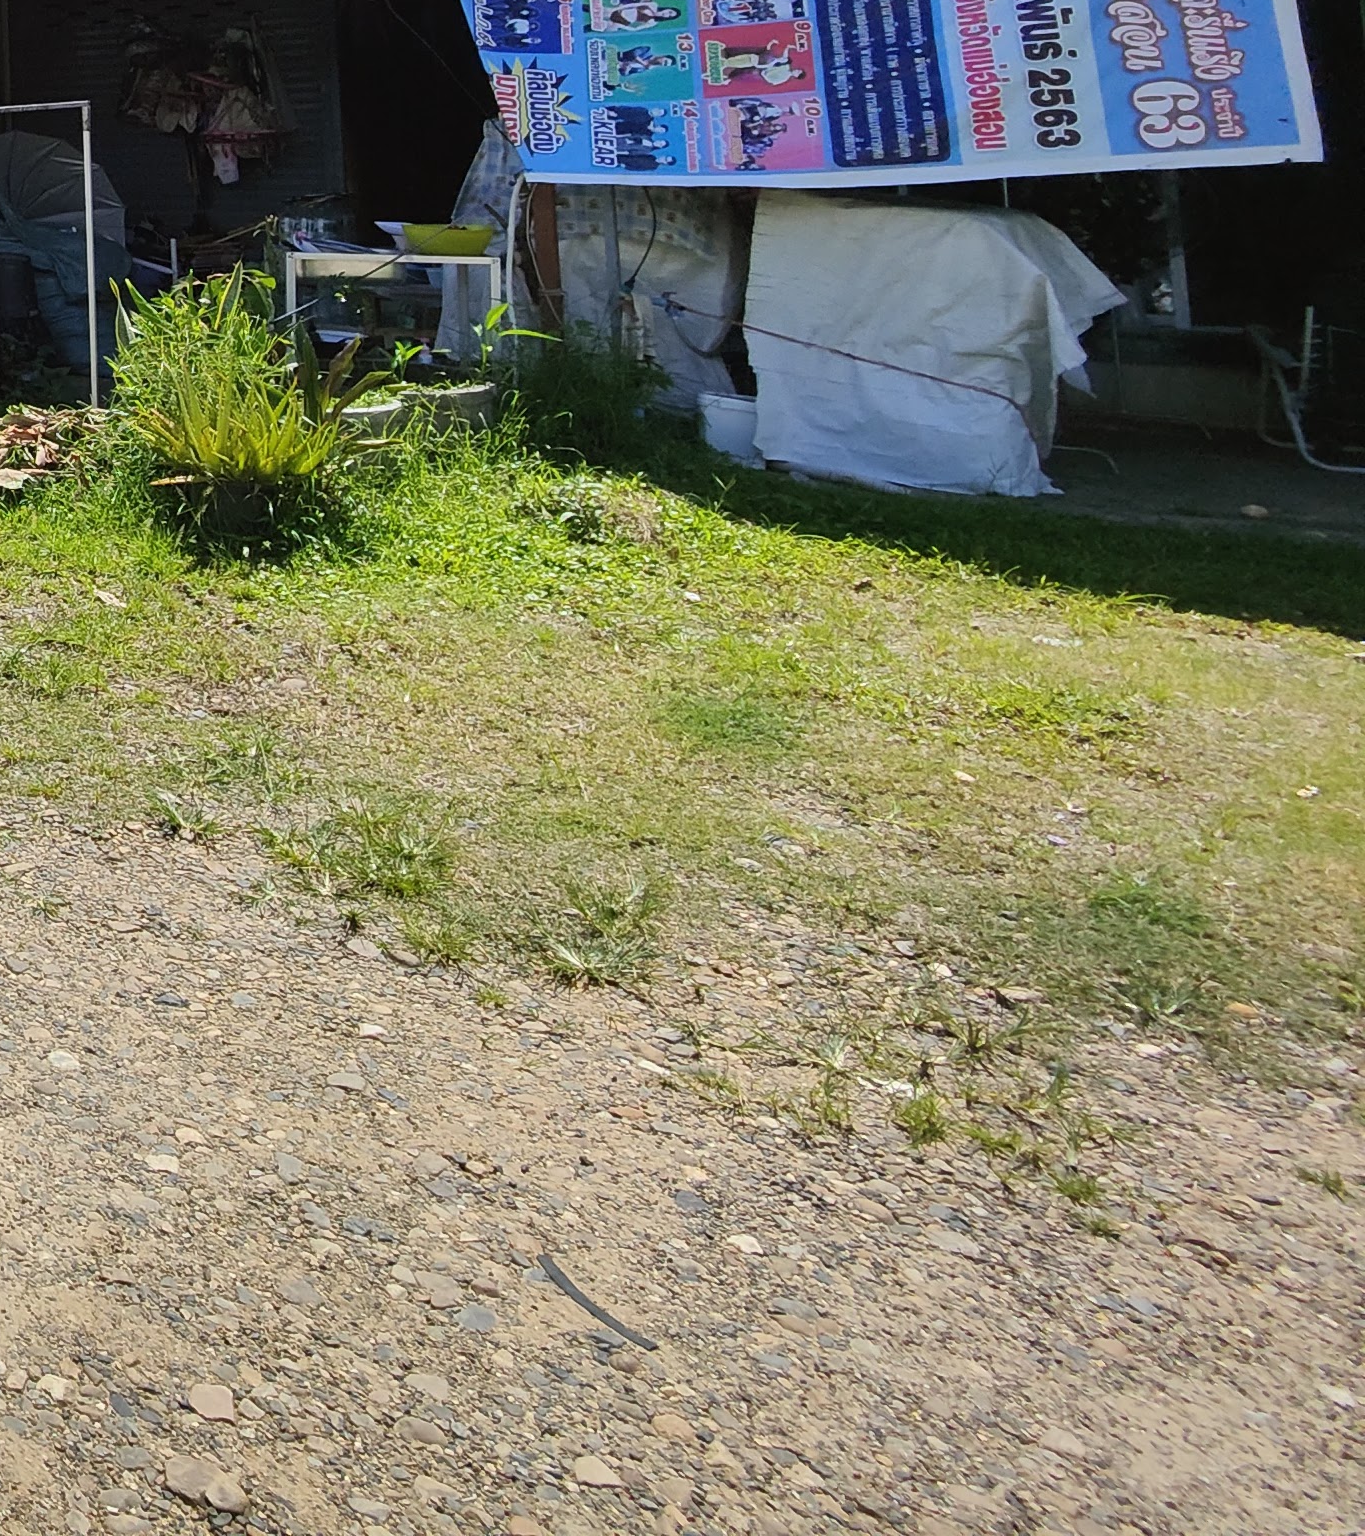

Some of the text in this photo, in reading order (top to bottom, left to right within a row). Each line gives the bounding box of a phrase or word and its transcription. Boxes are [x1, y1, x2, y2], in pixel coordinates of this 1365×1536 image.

[702, 11, 714, 24] One
[796, 22, 811, 30] 9
[677, 34, 692, 52] 13
[526, 71, 569, 151] ศิลปินชื่อดัง
[682, 101, 697, 118] 14
[804, 98, 819, 116] 10
[1025, 69, 1082, 148] 2563
[1130, 81, 1205, 148] 63
[1208, 88, 1243, 138] ประจำปี
[592, 121, 616, 166] KLEAR
